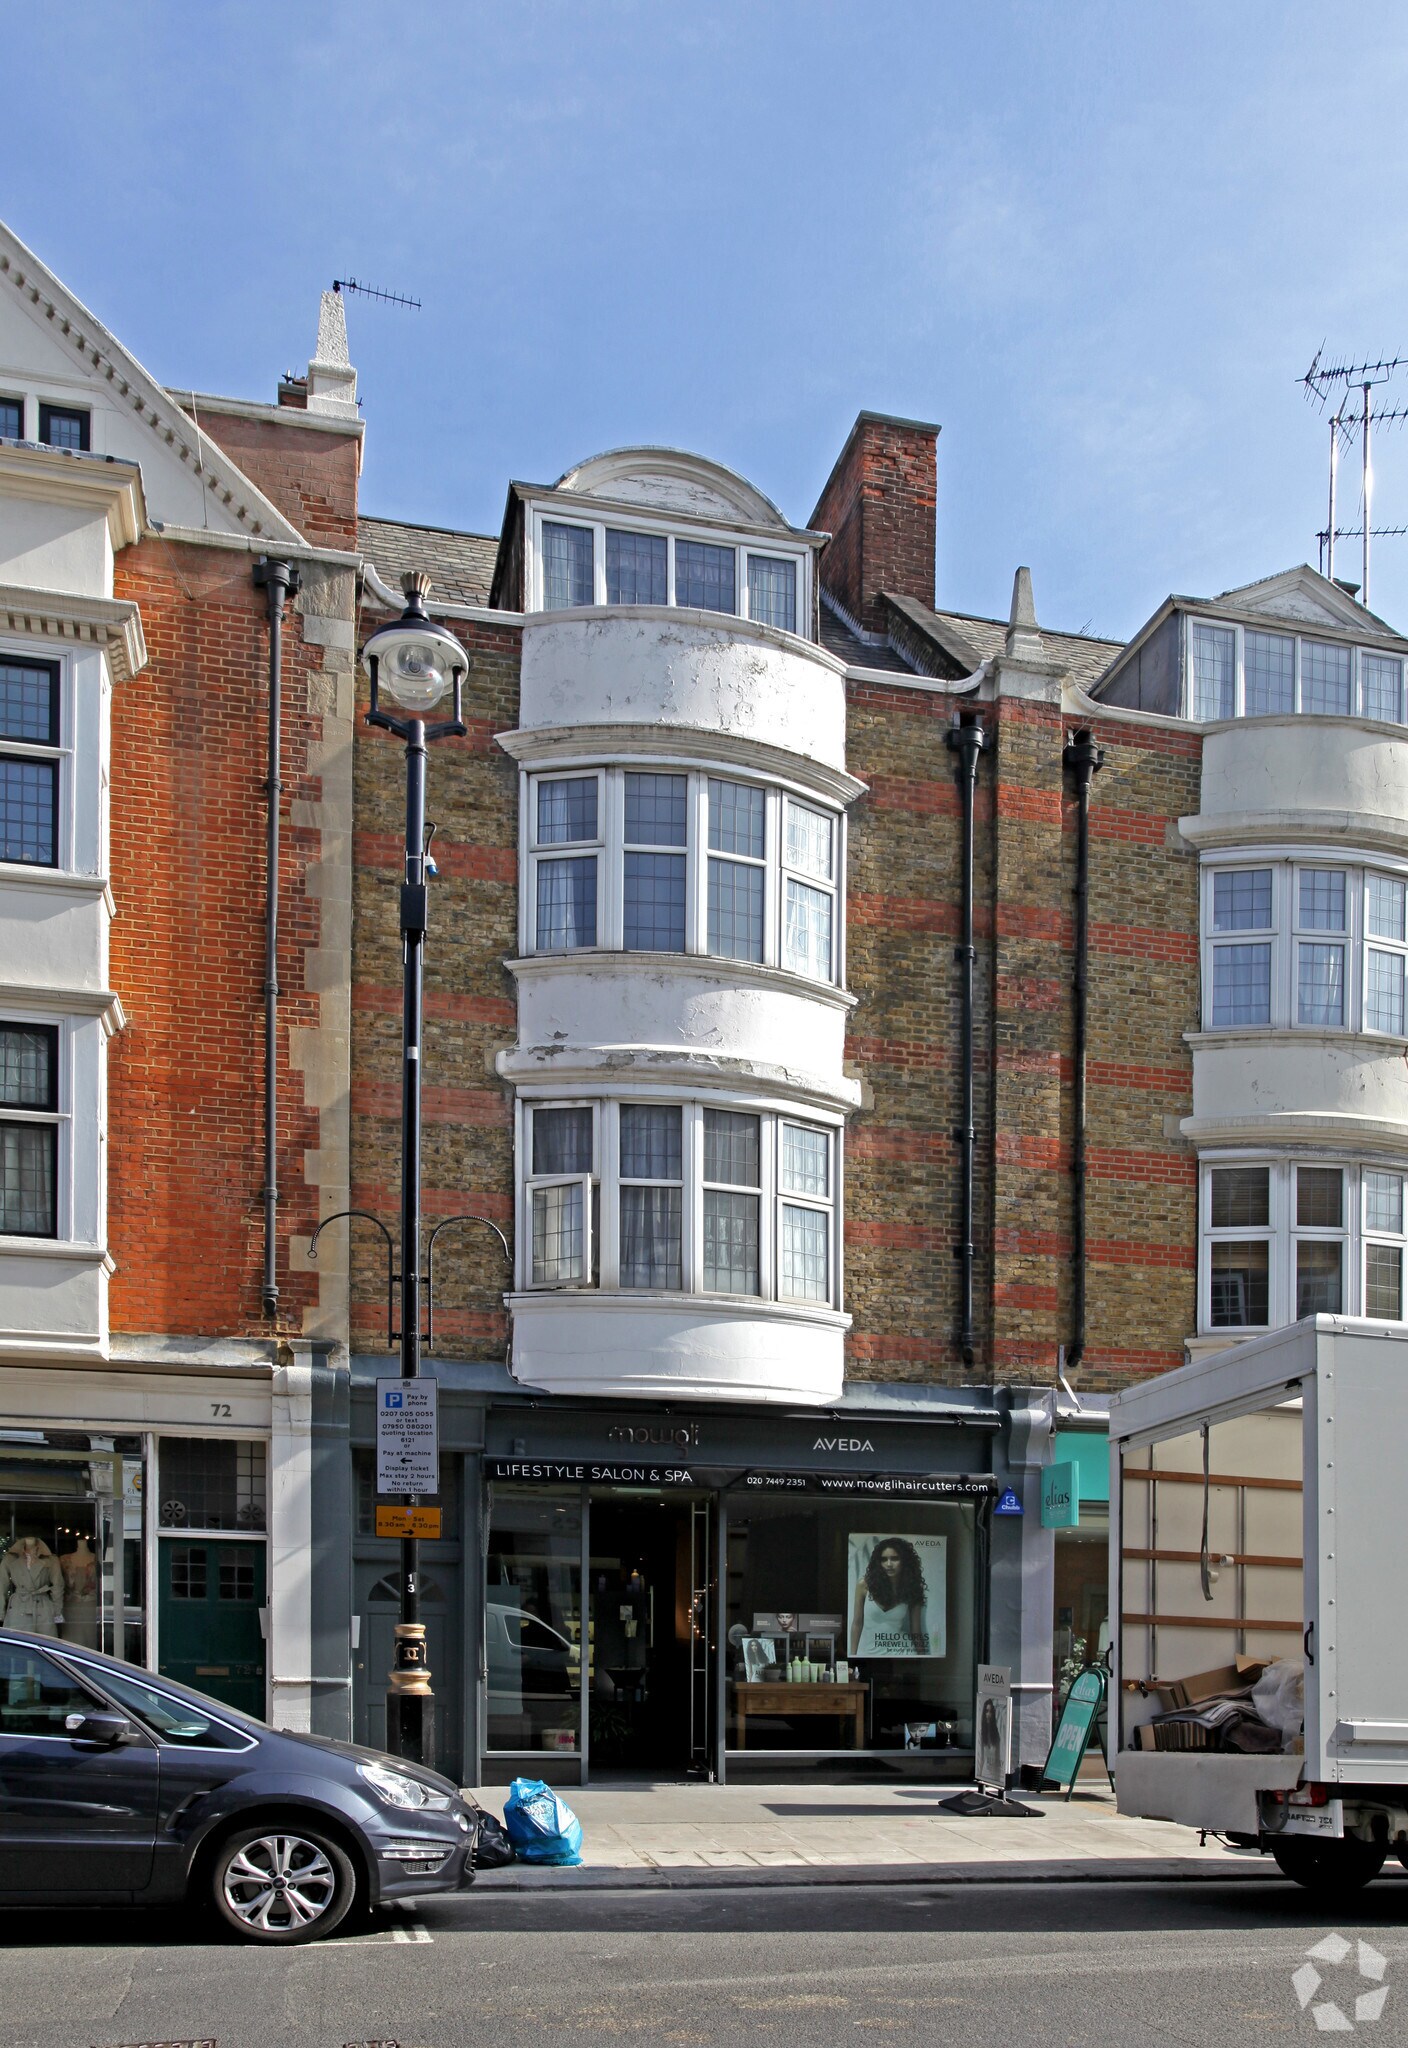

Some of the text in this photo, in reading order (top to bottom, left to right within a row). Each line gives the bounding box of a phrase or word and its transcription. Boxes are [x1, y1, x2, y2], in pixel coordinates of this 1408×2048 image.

[211, 1404, 232, 1417] 72
[608, 1422, 699, 1459] mowgli
[813, 1438, 874, 1452] AVEDA
[496, 1464, 692, 1482] LIFESTYLE SALON & SPA
[747, 1477, 806, 1486] 020 7449 2351
[822, 1478, 988, 1492] www.mowglihaircutters.com
[1046, 1480, 1070, 1506] elias
[874, 1632, 900, 1640] HELLO
[984, 1673, 1004, 1684] AVEDA
[1056, 1724, 1086, 1752] OPEN
